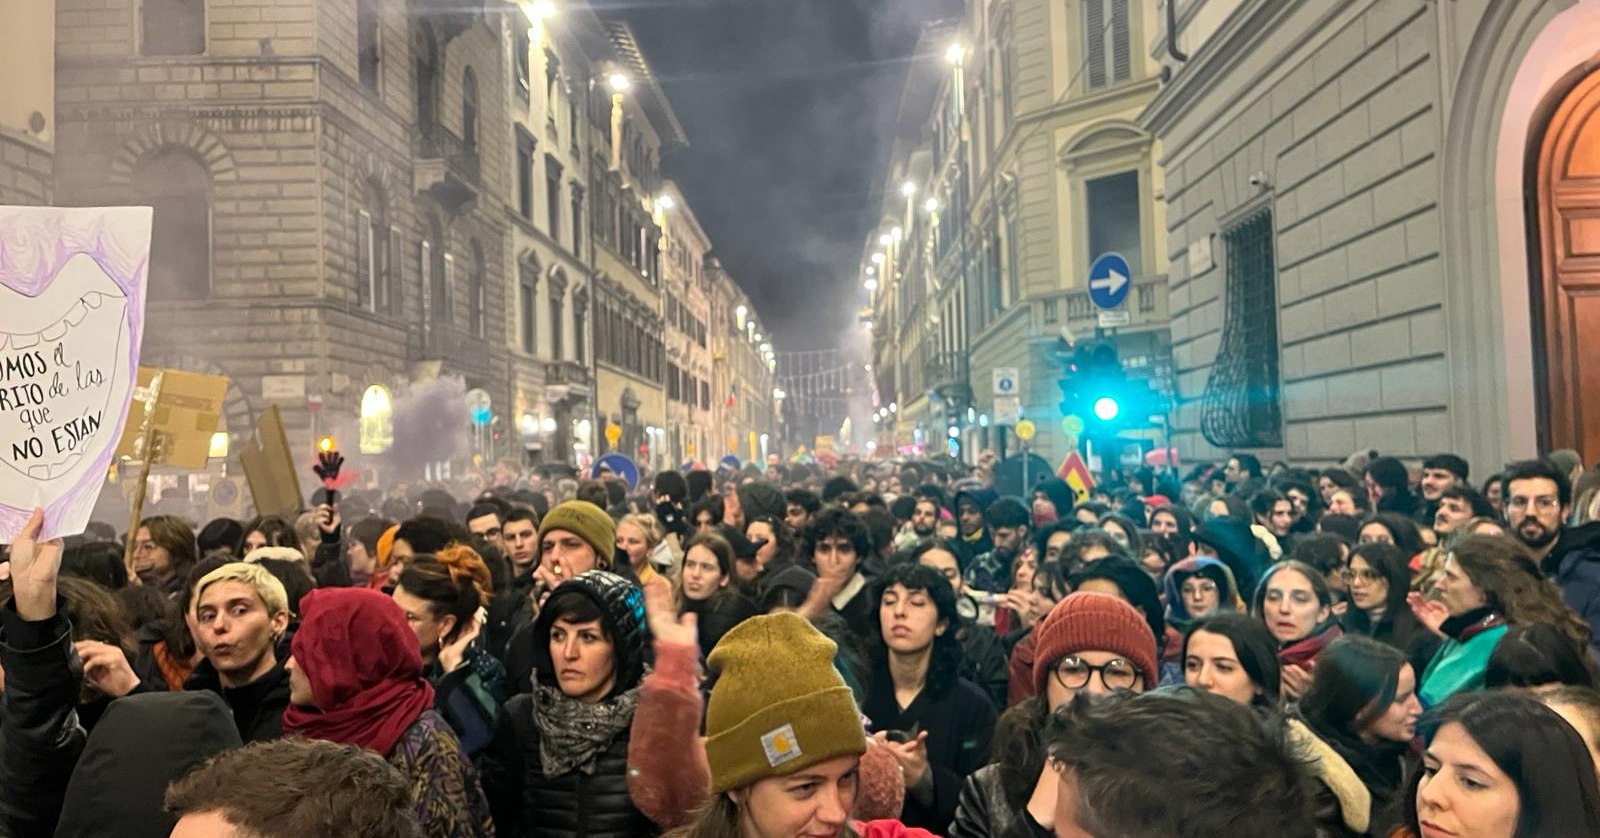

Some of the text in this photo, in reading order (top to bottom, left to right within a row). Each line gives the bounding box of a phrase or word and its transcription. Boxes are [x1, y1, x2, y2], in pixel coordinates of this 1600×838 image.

[54, 342, 72, 368] el
[49, 372, 69, 398] de
[76, 360, 107, 391] las
[12, 406, 101, 461] NO ESTÁN
[20, 407, 53, 433] que
